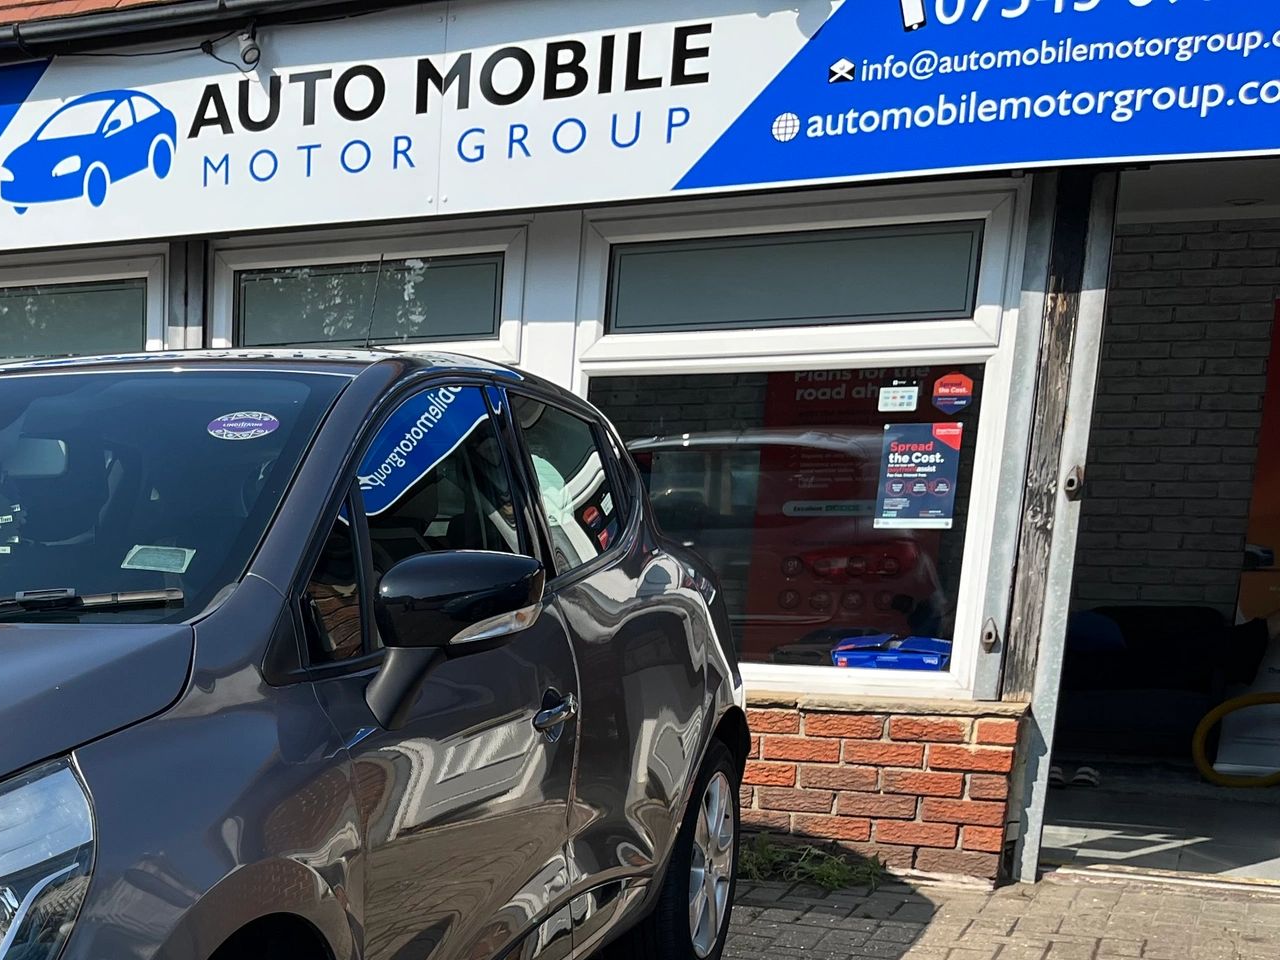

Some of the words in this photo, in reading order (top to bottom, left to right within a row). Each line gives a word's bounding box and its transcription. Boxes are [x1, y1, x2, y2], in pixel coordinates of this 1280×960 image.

[187, 64, 386, 139] AUTO
[415, 22, 713, 115] MOBILE
[806, 79, 1280, 138] automobilemotorgroup.co
[203, 134, 415, 188] MOTOR
[457, 106, 691, 164] GROUP
[796, 384, 846, 400] road
[888, 453, 910, 464] the
[911, 452, 944, 464] Cost.
[890, 441, 933, 454] Spread
